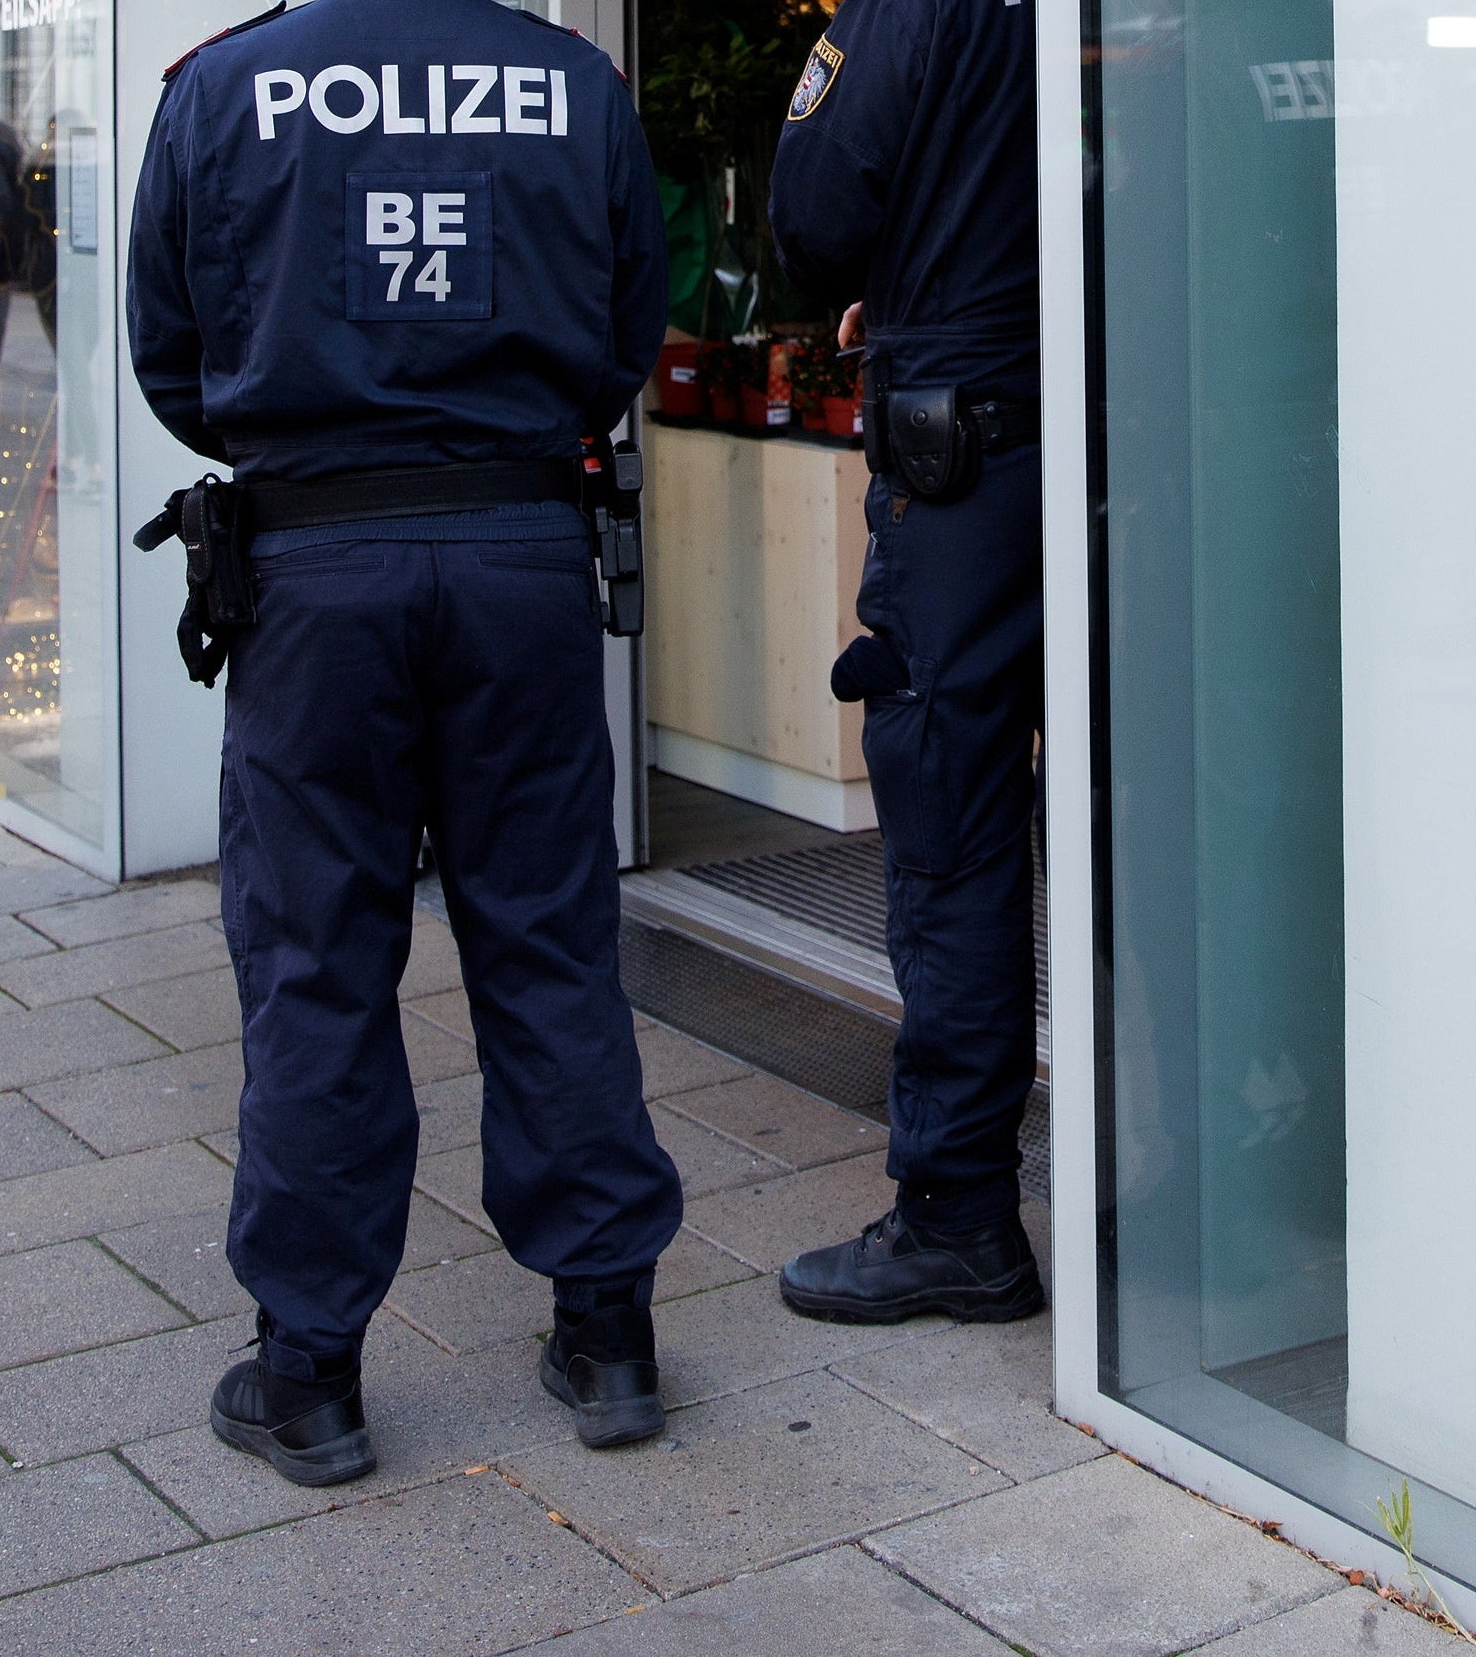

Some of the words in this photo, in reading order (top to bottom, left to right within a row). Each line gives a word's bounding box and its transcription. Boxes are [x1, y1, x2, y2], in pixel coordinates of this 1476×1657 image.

[254, 64, 568, 141] POLIZEI
[366, 192, 467, 245] BE
[379, 250, 451, 302] 74
